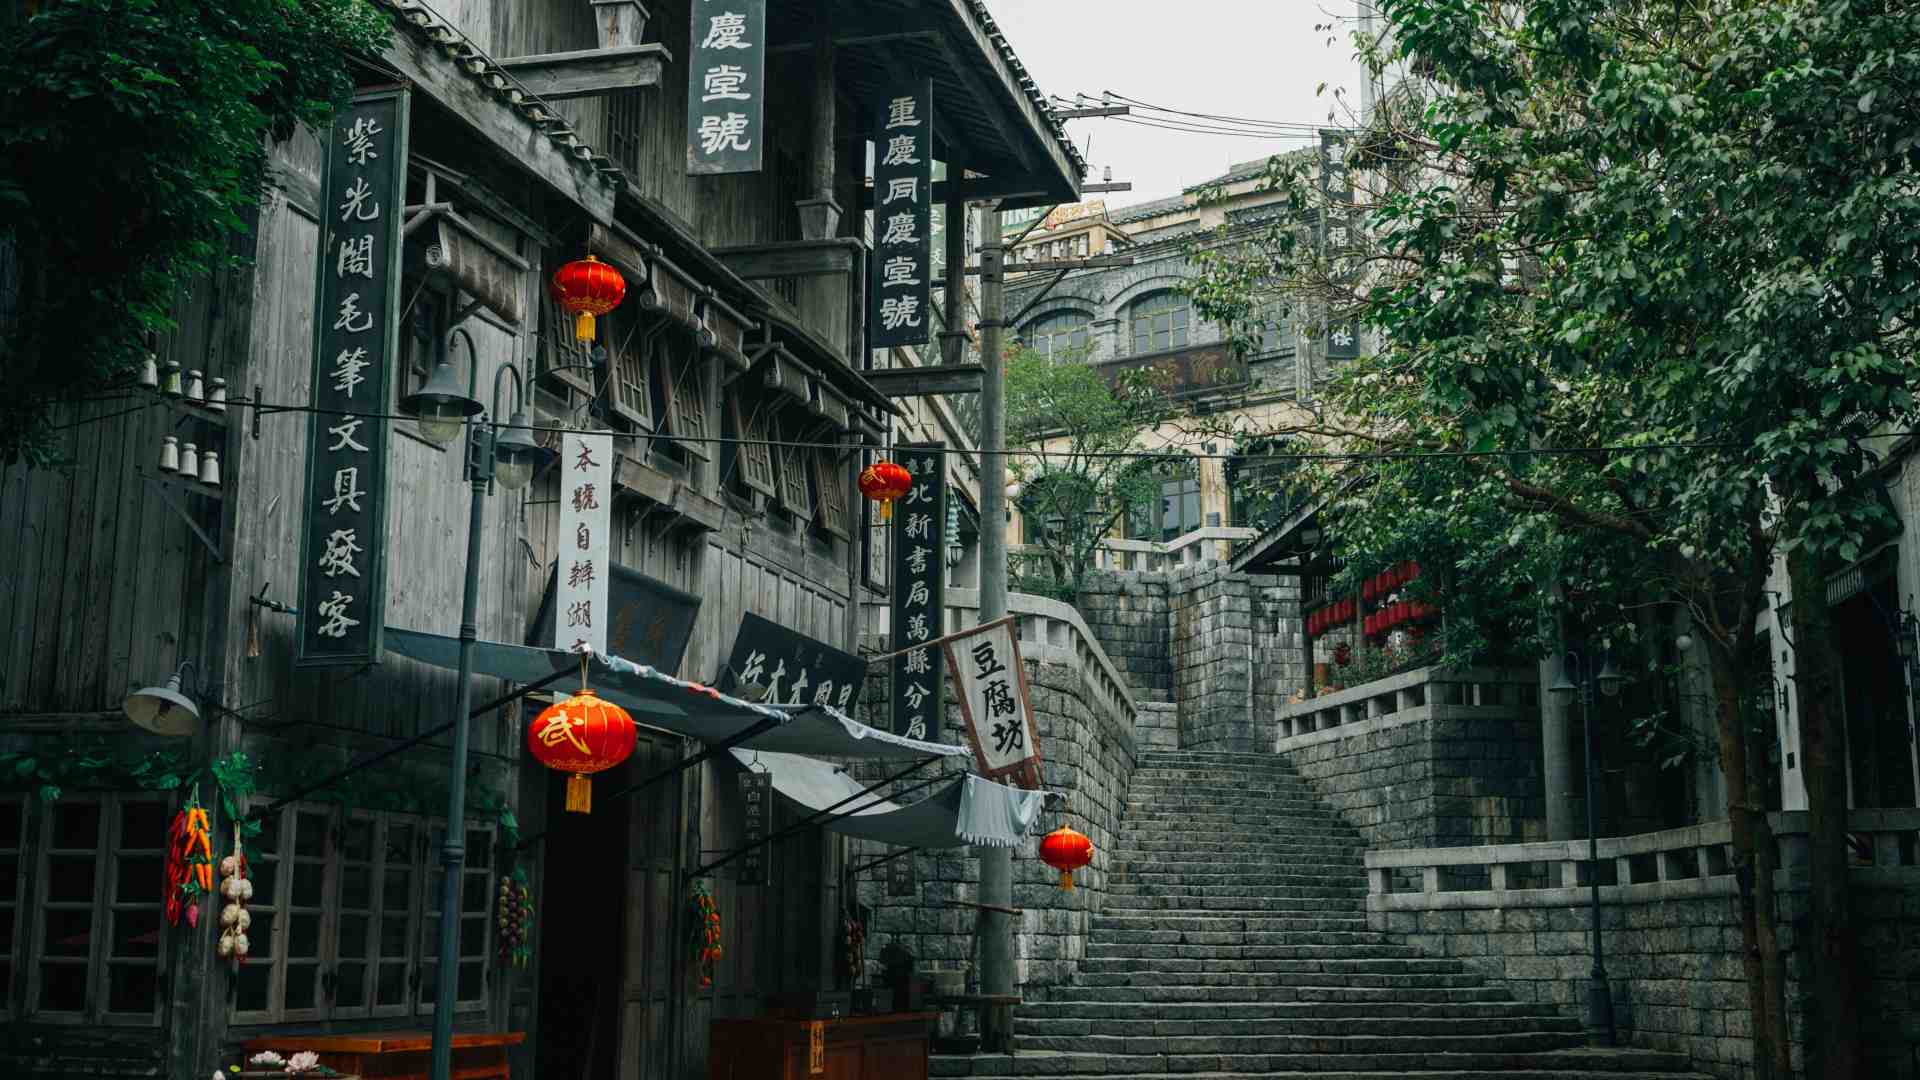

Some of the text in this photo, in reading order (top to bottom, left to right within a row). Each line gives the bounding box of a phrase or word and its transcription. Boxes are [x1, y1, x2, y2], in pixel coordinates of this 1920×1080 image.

[698, 0, 753, 155] 慶堂號
[880, 96, 921, 330] 重慶同慶堂號
[904, 482, 934, 741] 北新書局萬縣分局
[972, 641, 1024, 757] 豆腐坊
